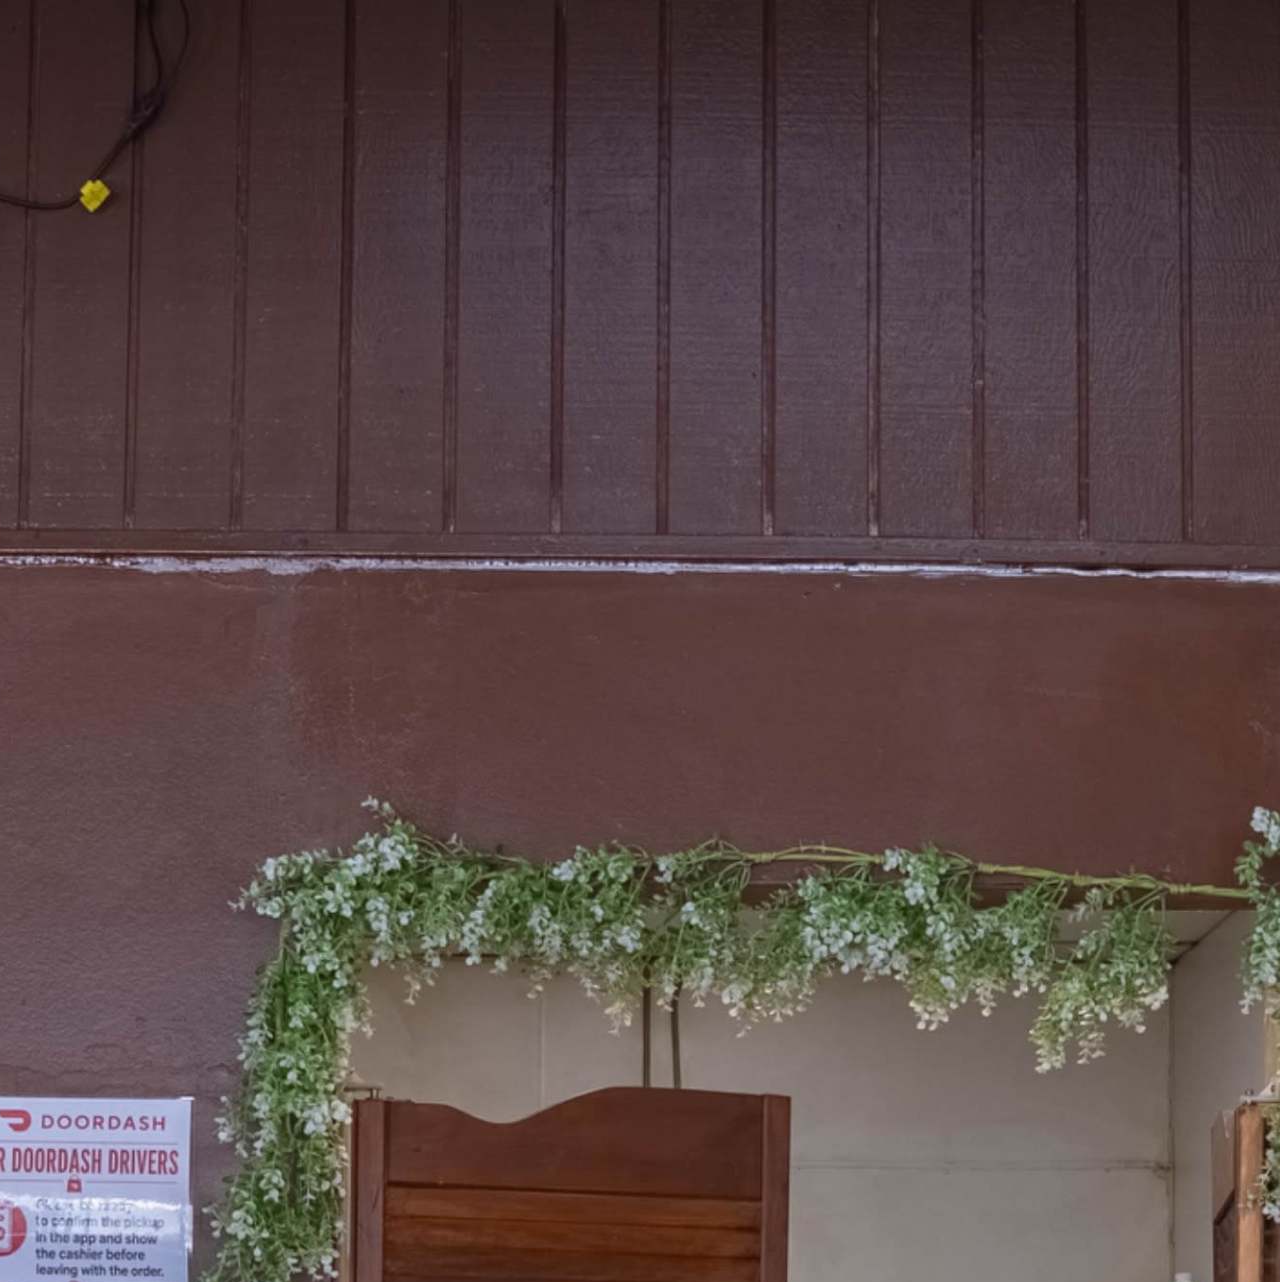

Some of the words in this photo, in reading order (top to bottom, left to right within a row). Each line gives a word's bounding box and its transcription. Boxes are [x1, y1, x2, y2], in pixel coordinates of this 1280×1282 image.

[41, 1115, 166, 1131] DOORDASH
[11, 1148, 102, 1175] DOORDASH
[108, 1150, 179, 1176] DRIVERS
[35, 1215, 48, 1227] to
[101, 1215, 121, 1228] the
[124, 1216, 165, 1230] pickup
[35, 1231, 47, 1243] in
[50, 1231, 70, 1244] the
[72, 1234, 96, 1246] app
[99, 1233, 122, 1245] and
[125, 1233, 159, 1246] show
[35, 1247, 56, 1260] the
[59, 1248, 104, 1261] cashier
[106, 1248, 146, 1261] before
[35, 1263, 79, 1278] leaving
[81, 1264, 107, 1276] with
[108, 1265, 129, 1277] the
[131, 1265, 166, 1278] order.
